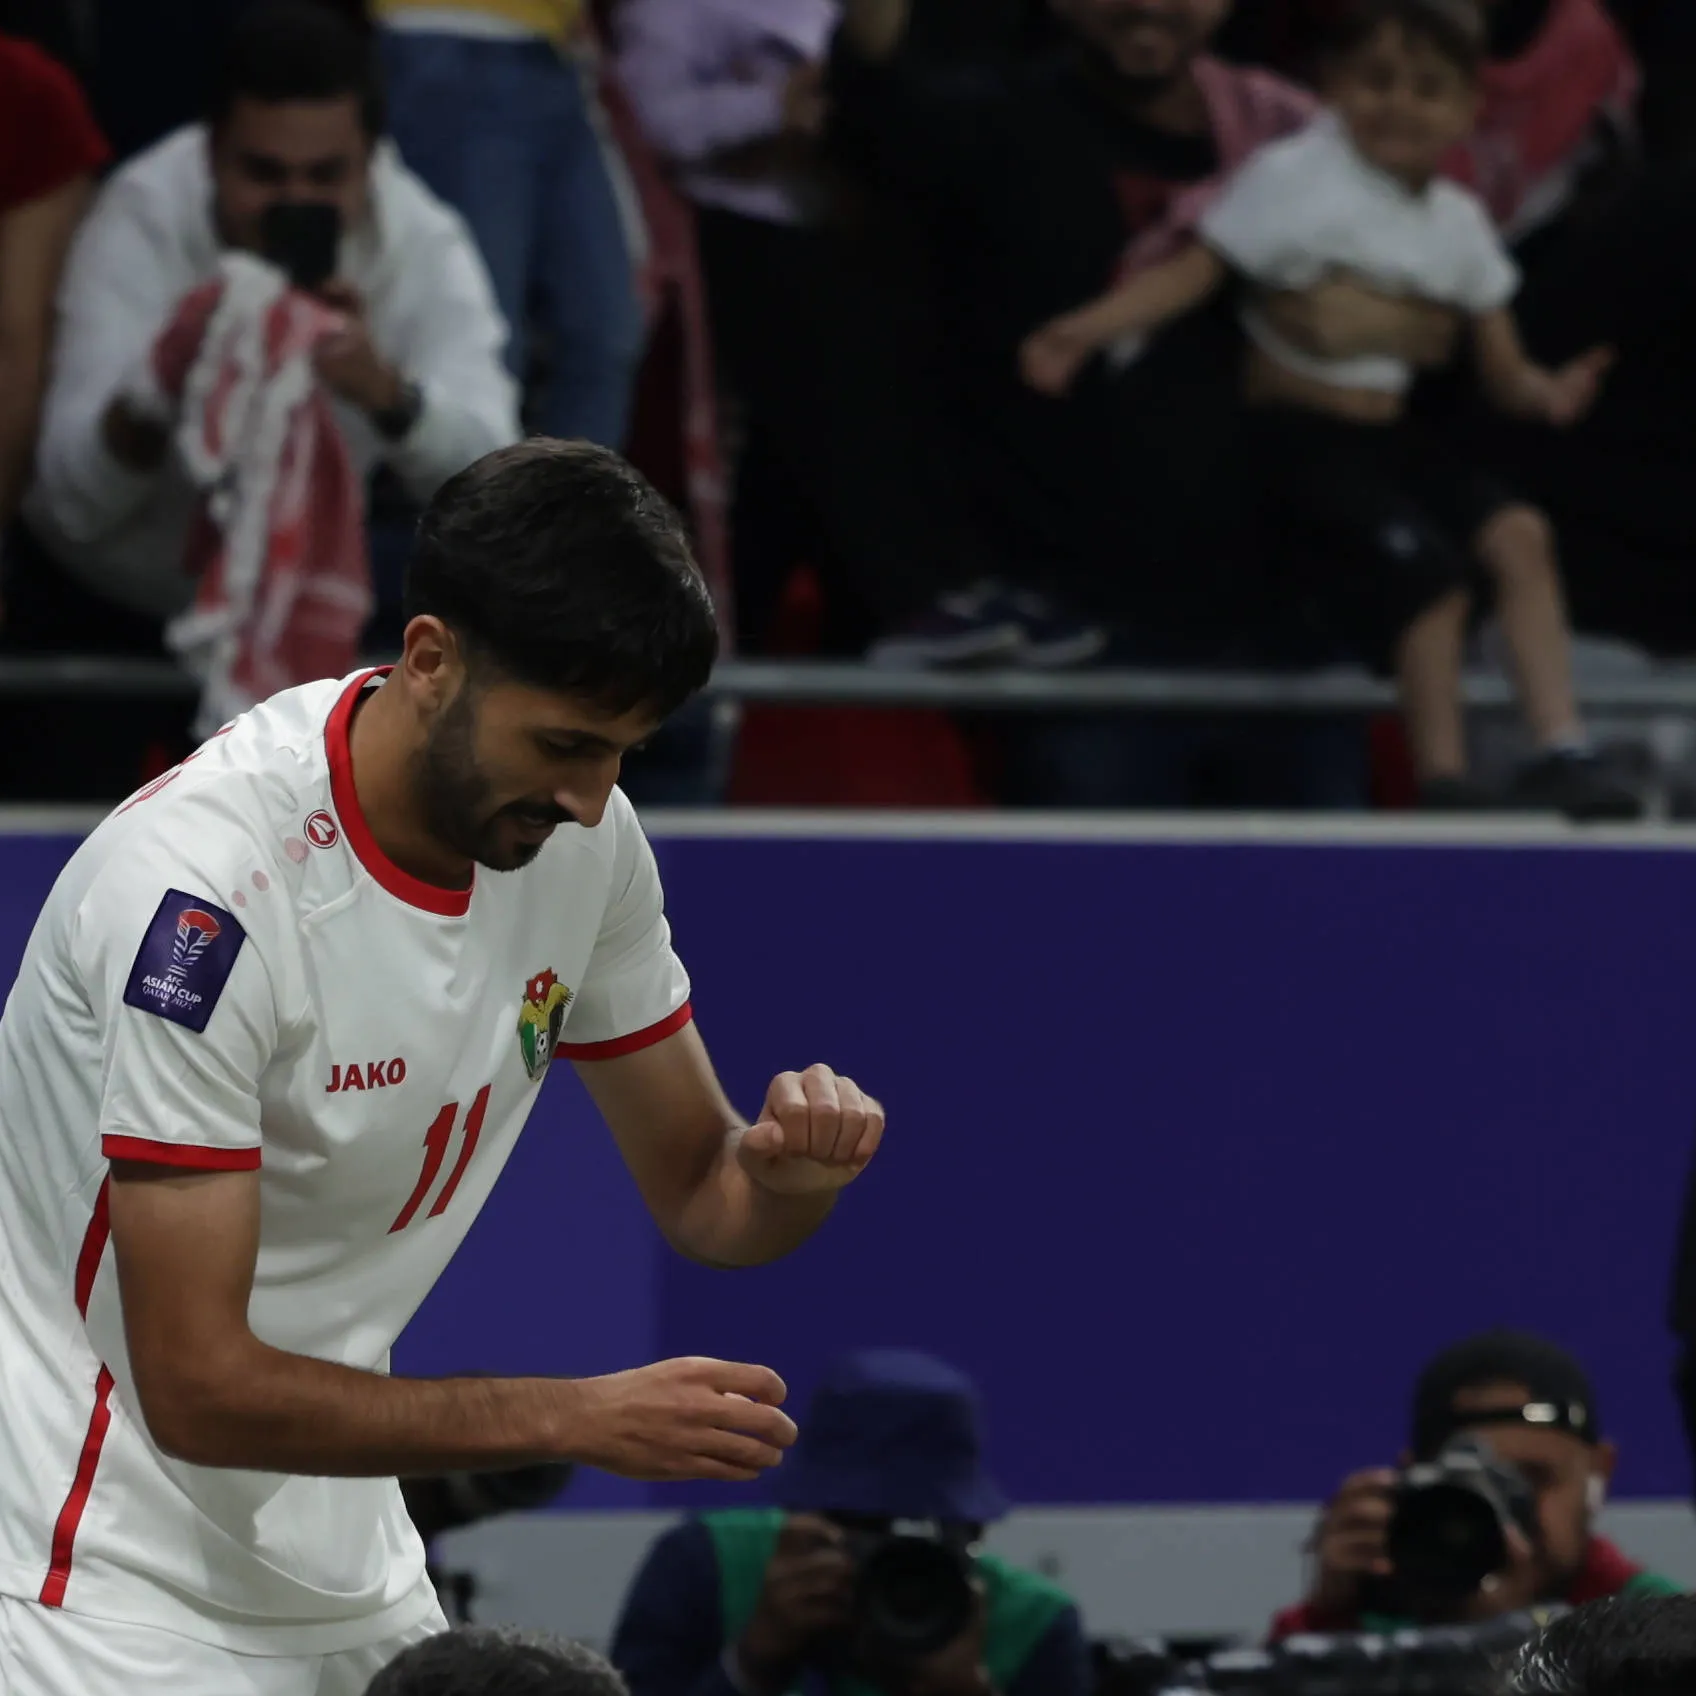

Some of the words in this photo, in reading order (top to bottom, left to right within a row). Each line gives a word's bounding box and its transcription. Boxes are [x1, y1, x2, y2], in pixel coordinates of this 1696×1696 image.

[142, 974, 178, 995] ASIAN
[177, 988, 203, 1004] CUP
[142, 985, 170, 1001] QATAR
[165, 974, 184, 987] AFC
[325, 1057, 407, 1092] JAKO
[386, 1083, 492, 1235] 11
